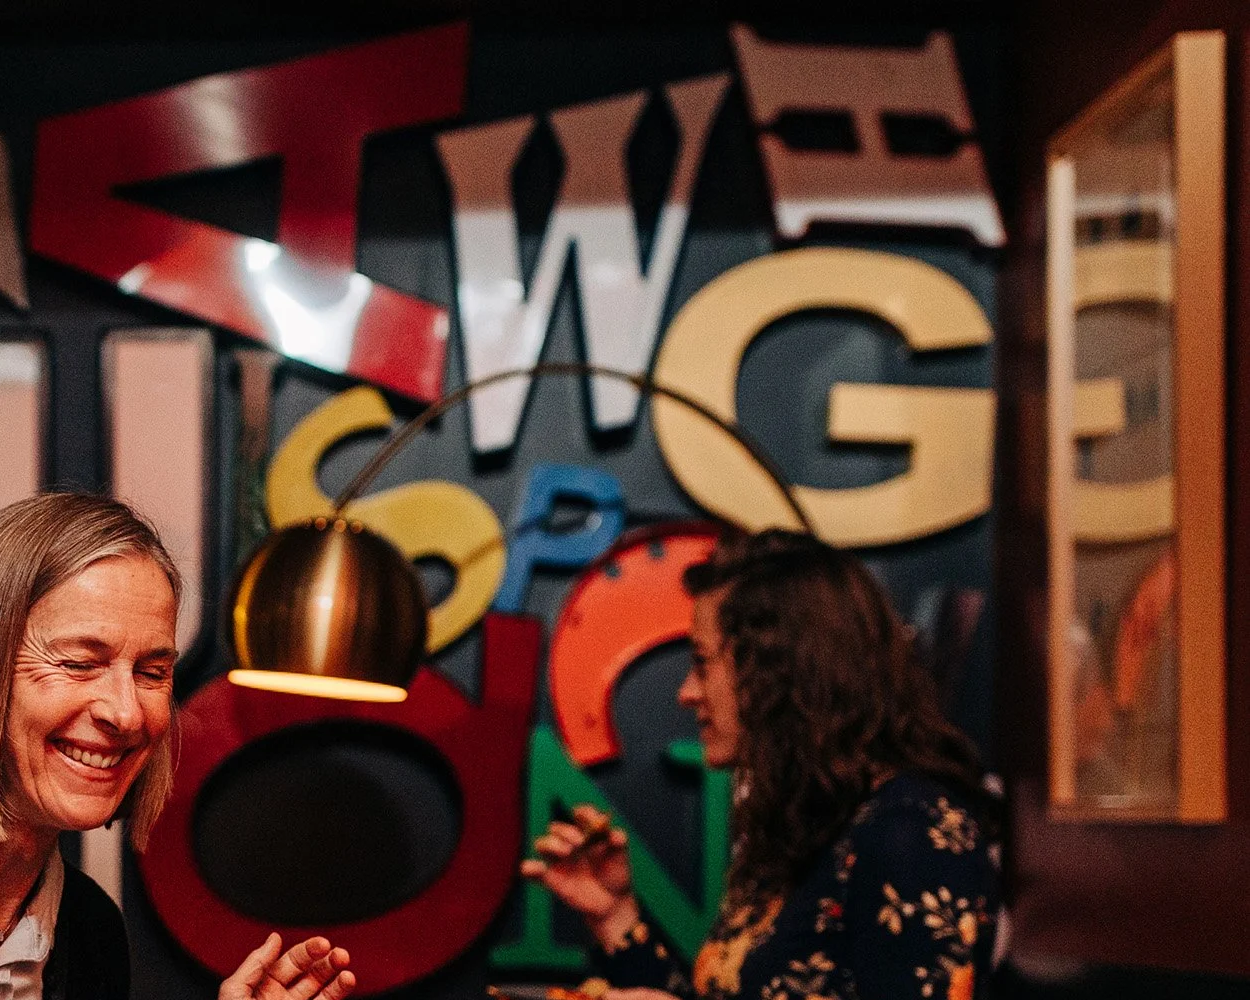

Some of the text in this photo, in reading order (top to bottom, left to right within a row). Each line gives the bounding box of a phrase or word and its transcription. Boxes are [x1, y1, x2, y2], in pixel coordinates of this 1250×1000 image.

[27, 16, 473, 403] A
[434, 70, 733, 458] W
[487, 464, 627, 613] P
[652, 245, 998, 551] G
